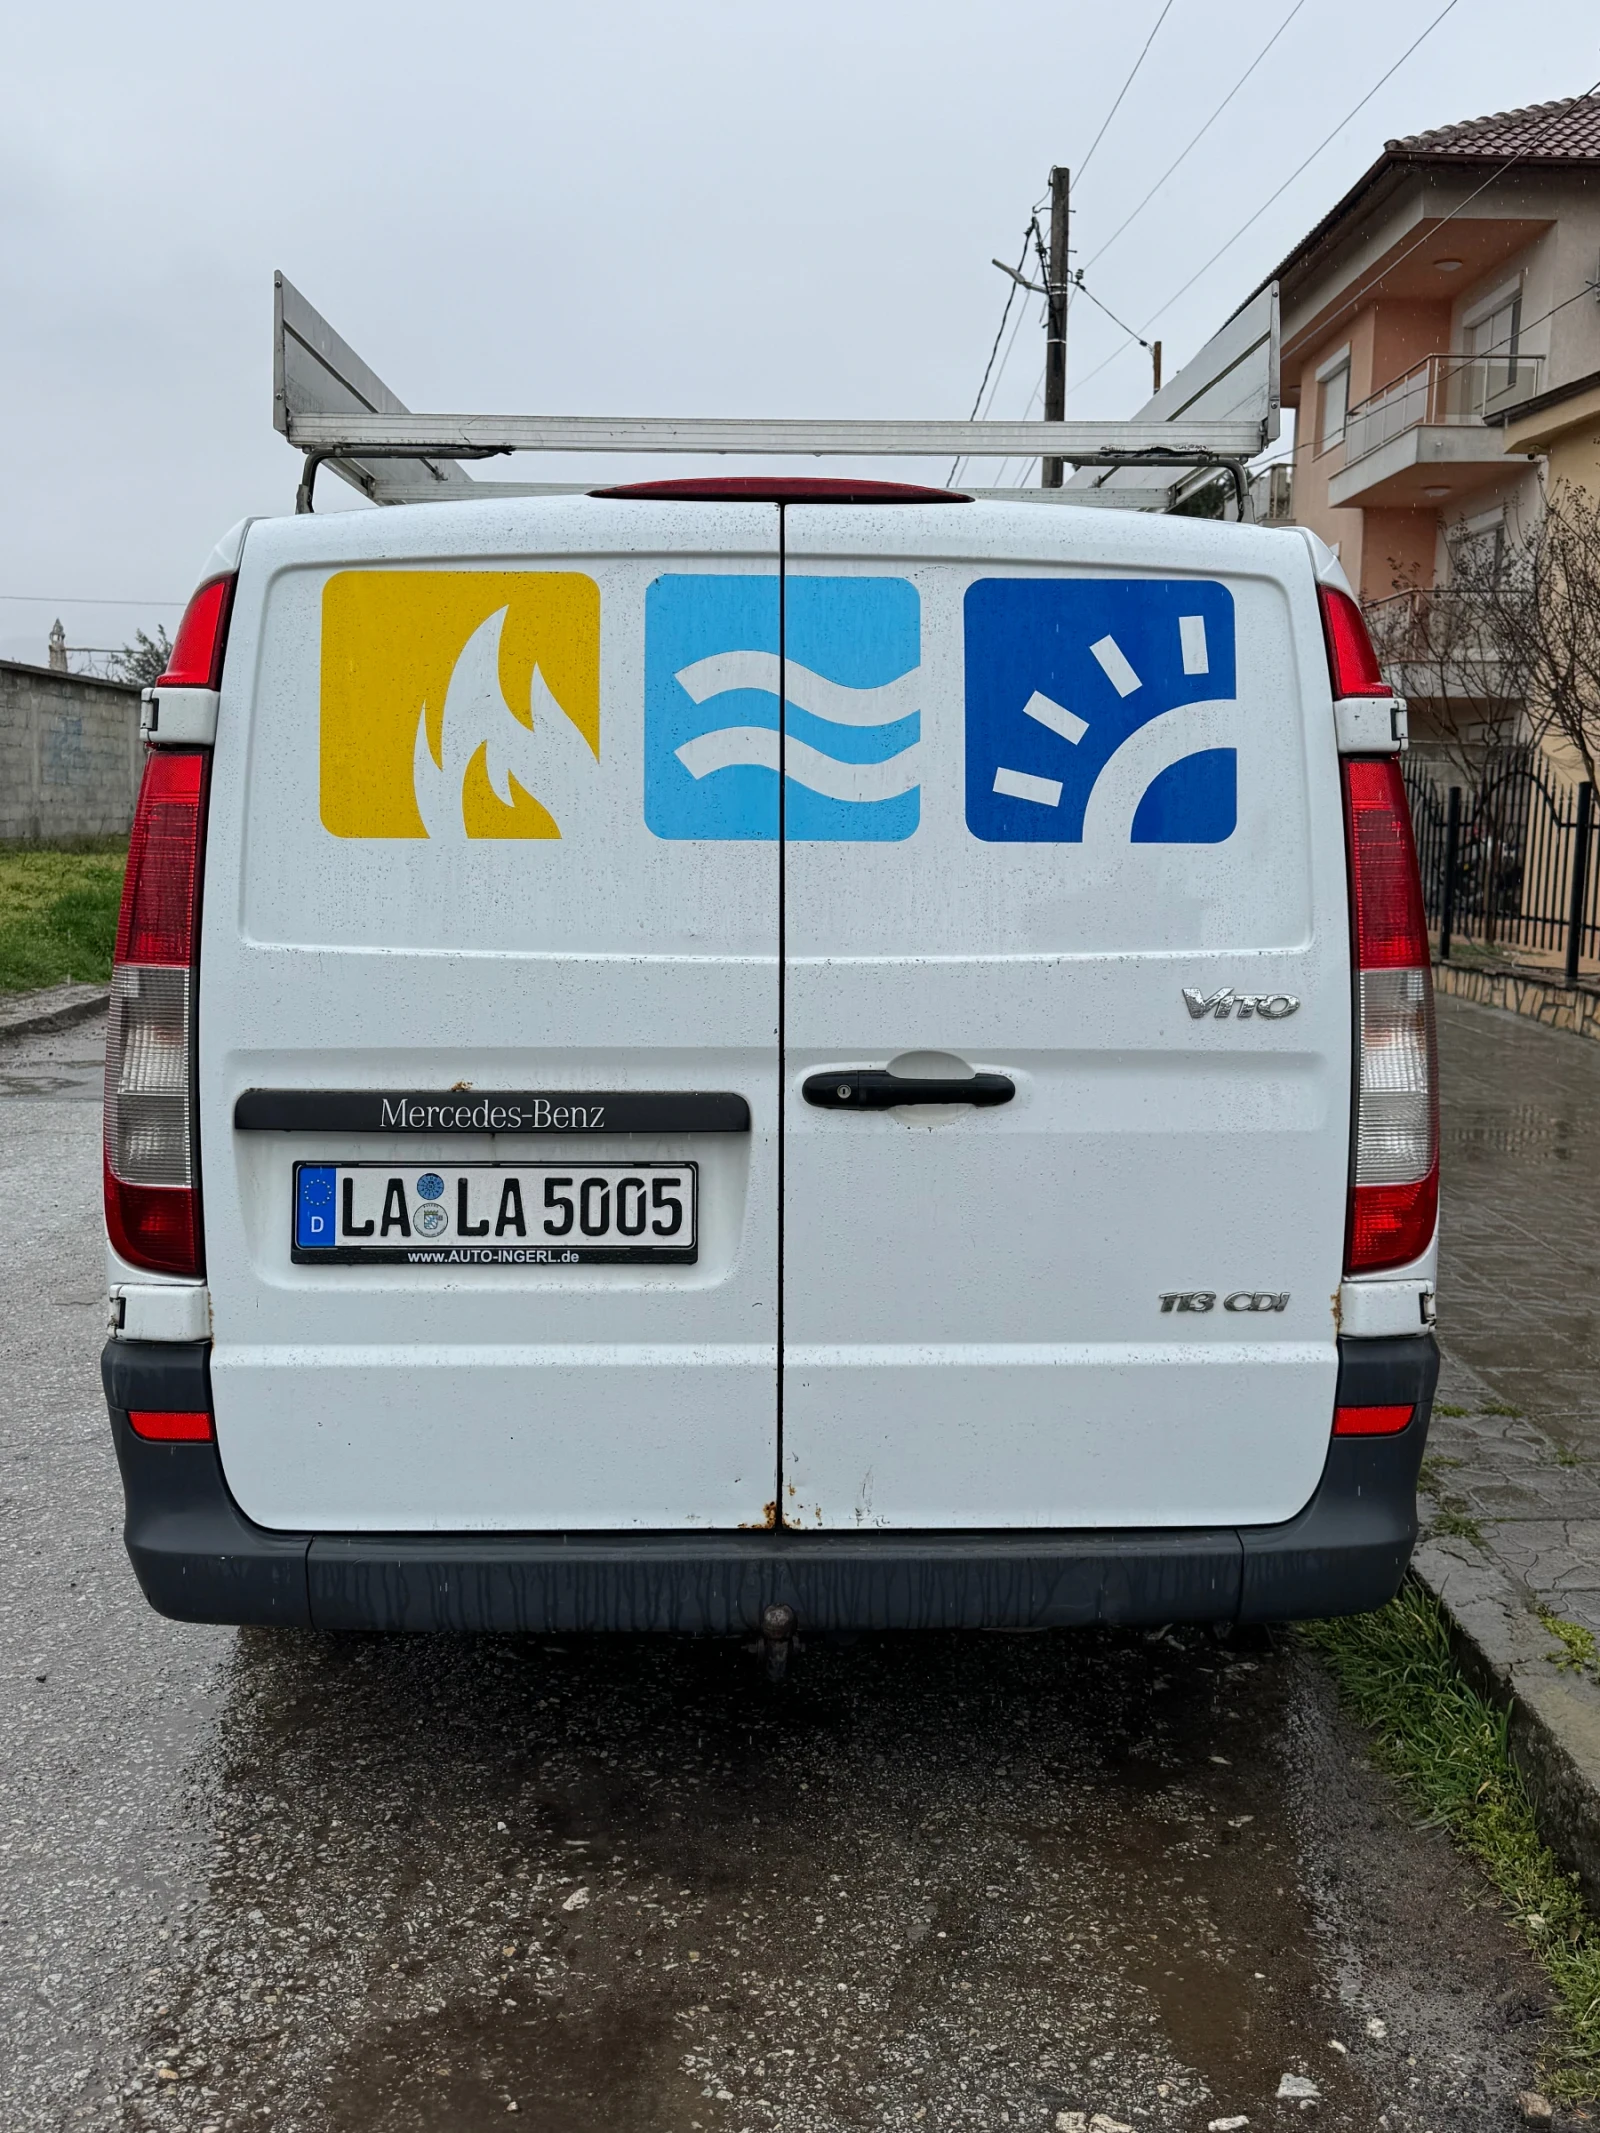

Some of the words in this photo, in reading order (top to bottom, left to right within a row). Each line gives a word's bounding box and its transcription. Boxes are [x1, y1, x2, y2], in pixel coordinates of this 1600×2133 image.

[379, 1098, 605, 1128] Mercedes-Benz
[341, 1177, 412, 1237] LA
[456, 1177, 527, 1237] LA
[543, 1177, 683, 1237] 5005
[310, 1216, 325, 1233] D
[407, 1250, 580, 1264] www.AUTO-INGERL.de
[1158, 1290, 1217, 1313] 113
[1223, 1290, 1292, 1312] CDI
